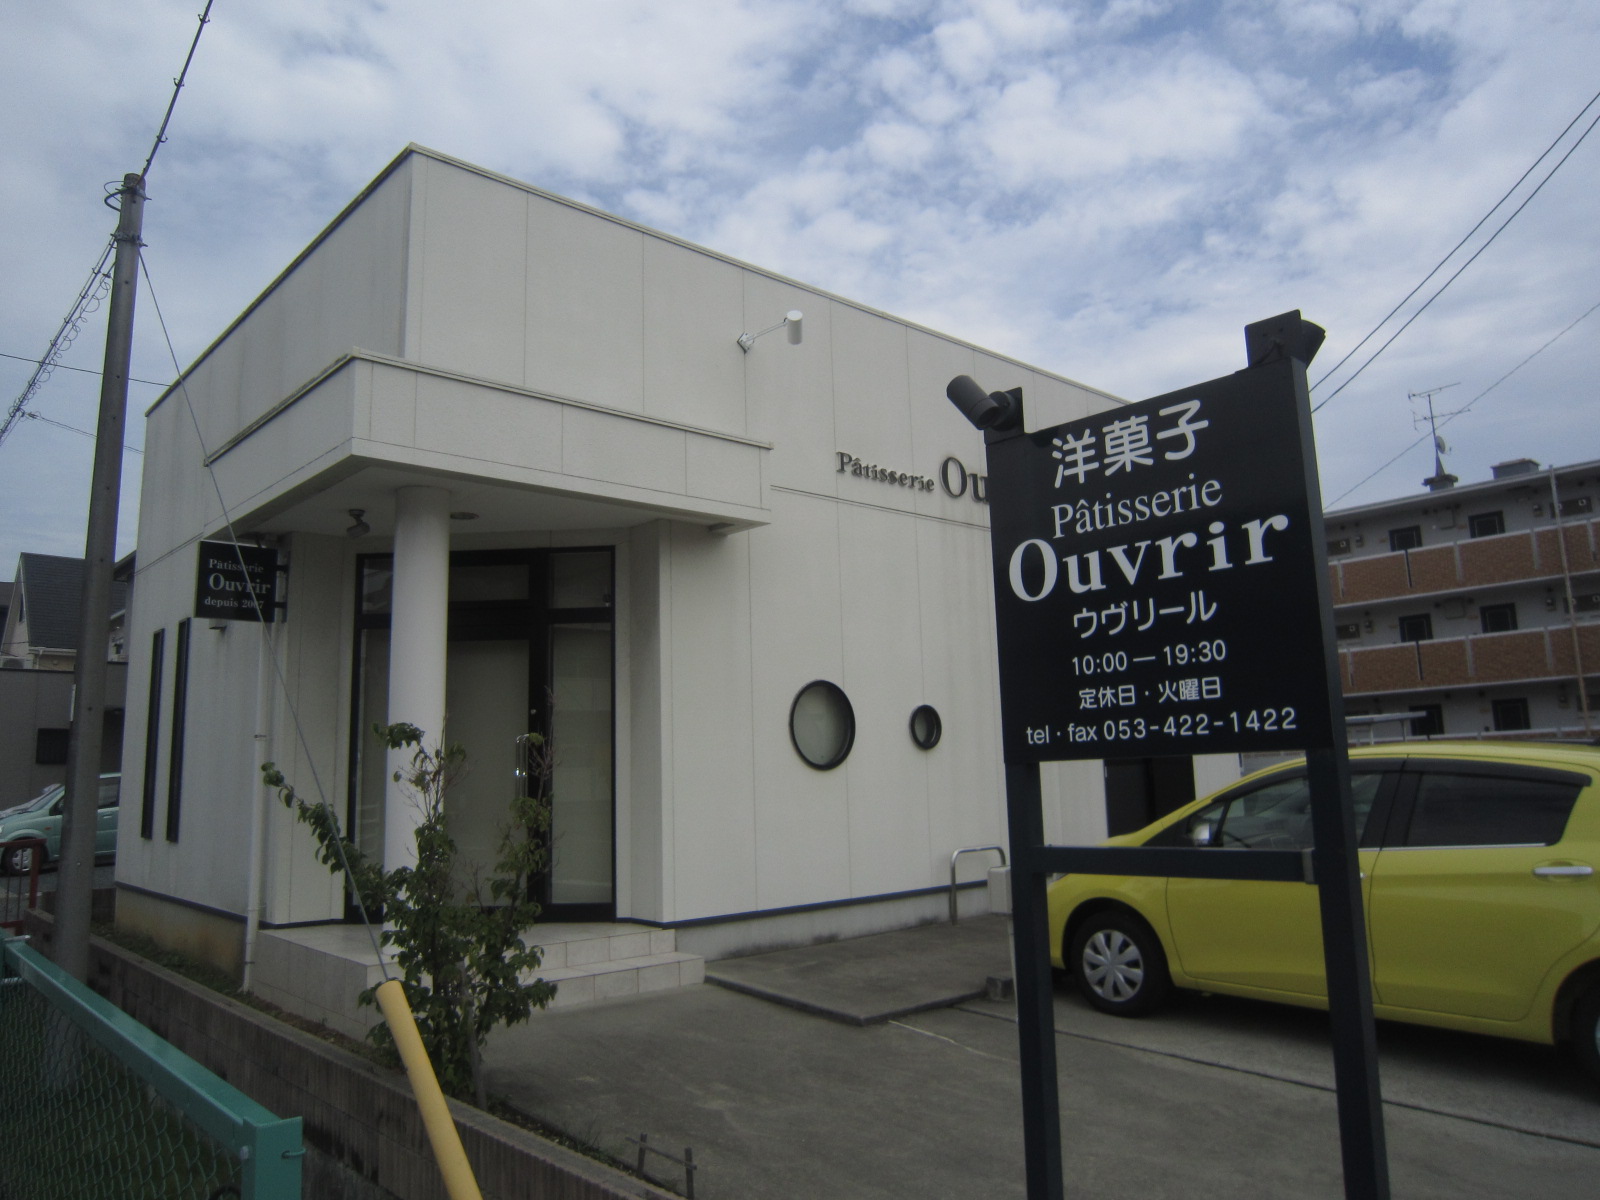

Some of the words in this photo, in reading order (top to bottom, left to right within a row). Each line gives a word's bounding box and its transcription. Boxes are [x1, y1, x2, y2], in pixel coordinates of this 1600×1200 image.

[1052, 399, 1209, 489] 洋菓子
[836, 451, 935, 493] Pâtisserie
[1051, 473, 1223, 539] Pâtisserie
[1008, 514, 1289, 602] Ouvrir
[204, 596, 238, 608] depuis
[208, 572, 271, 594] Ouvrir
[1073, 590, 1218, 639] ウヴリール
[1103, 707, 1297, 741] 053-422-1422
